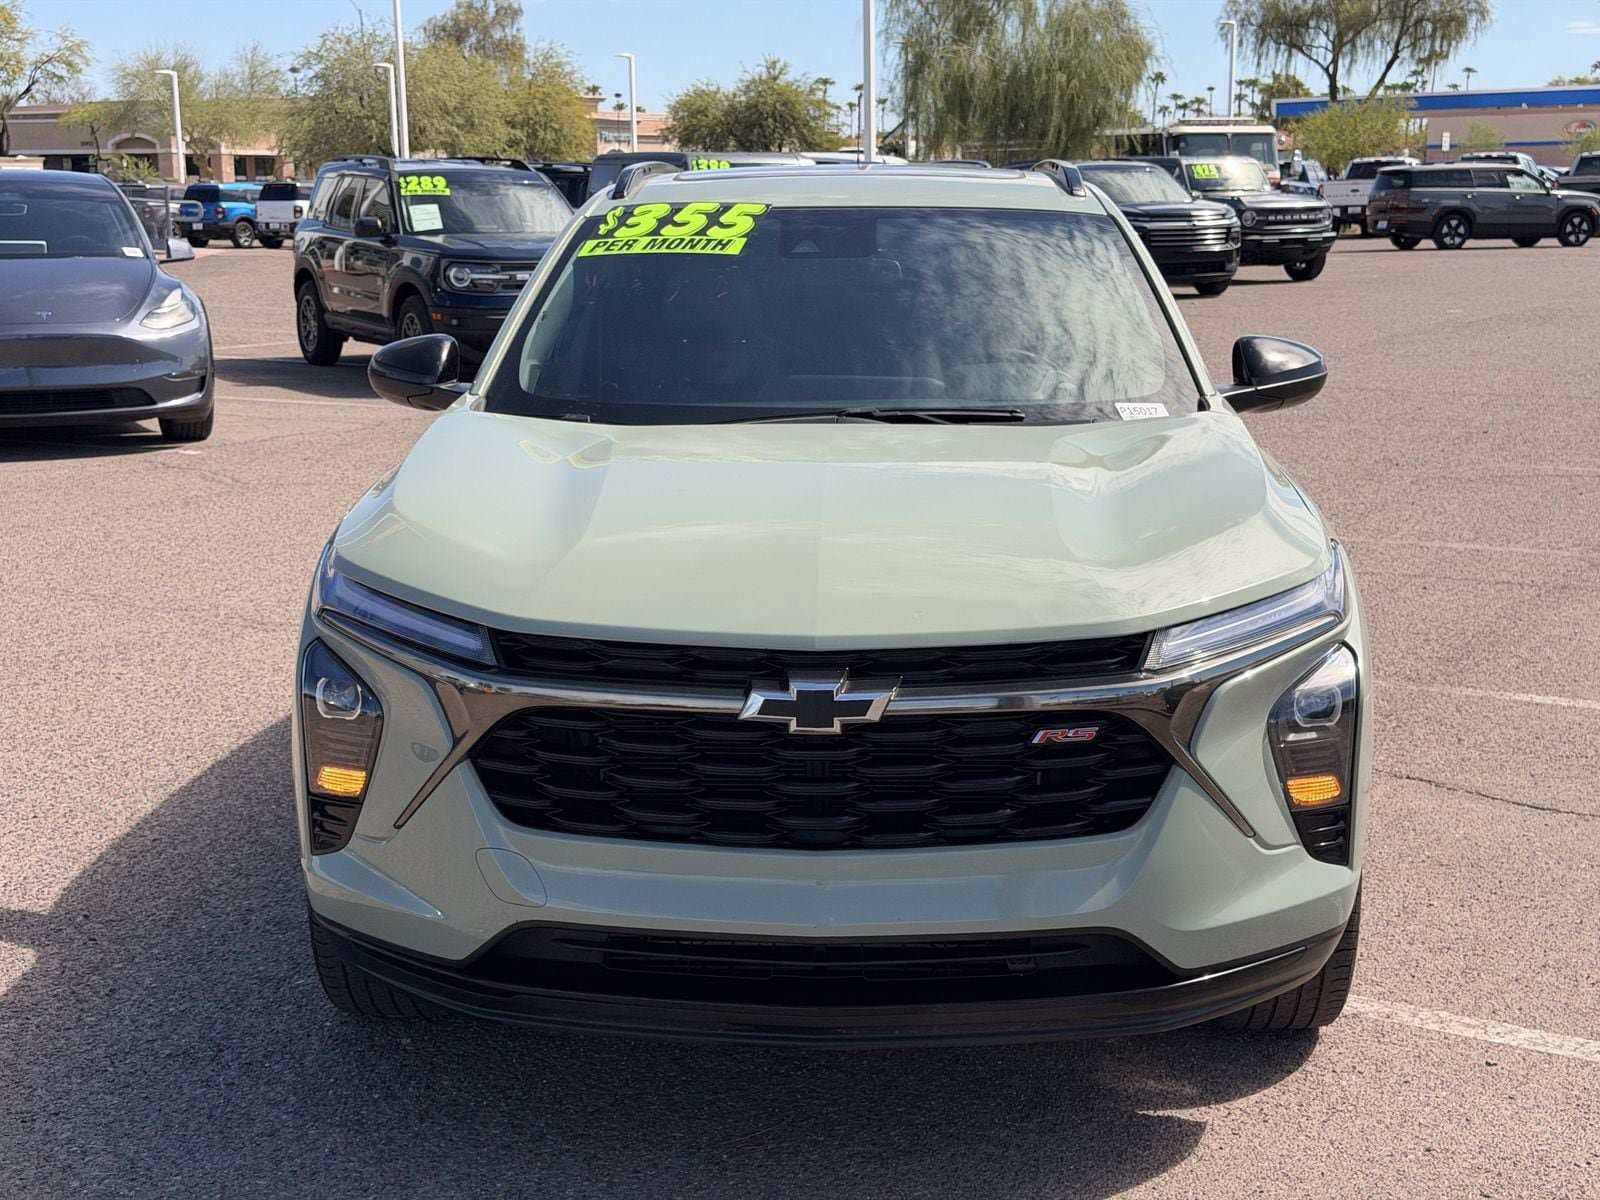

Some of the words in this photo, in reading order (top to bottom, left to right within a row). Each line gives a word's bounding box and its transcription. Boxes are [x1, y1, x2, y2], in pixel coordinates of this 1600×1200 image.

[399, 175, 447, 190] $289
[598, 202, 768, 238] $355
[588, 239, 640, 253] PER
[642, 237, 735, 252] MONTH
[1119, 406, 1159, 416] P15017
[1031, 726, 1099, 744] RS
